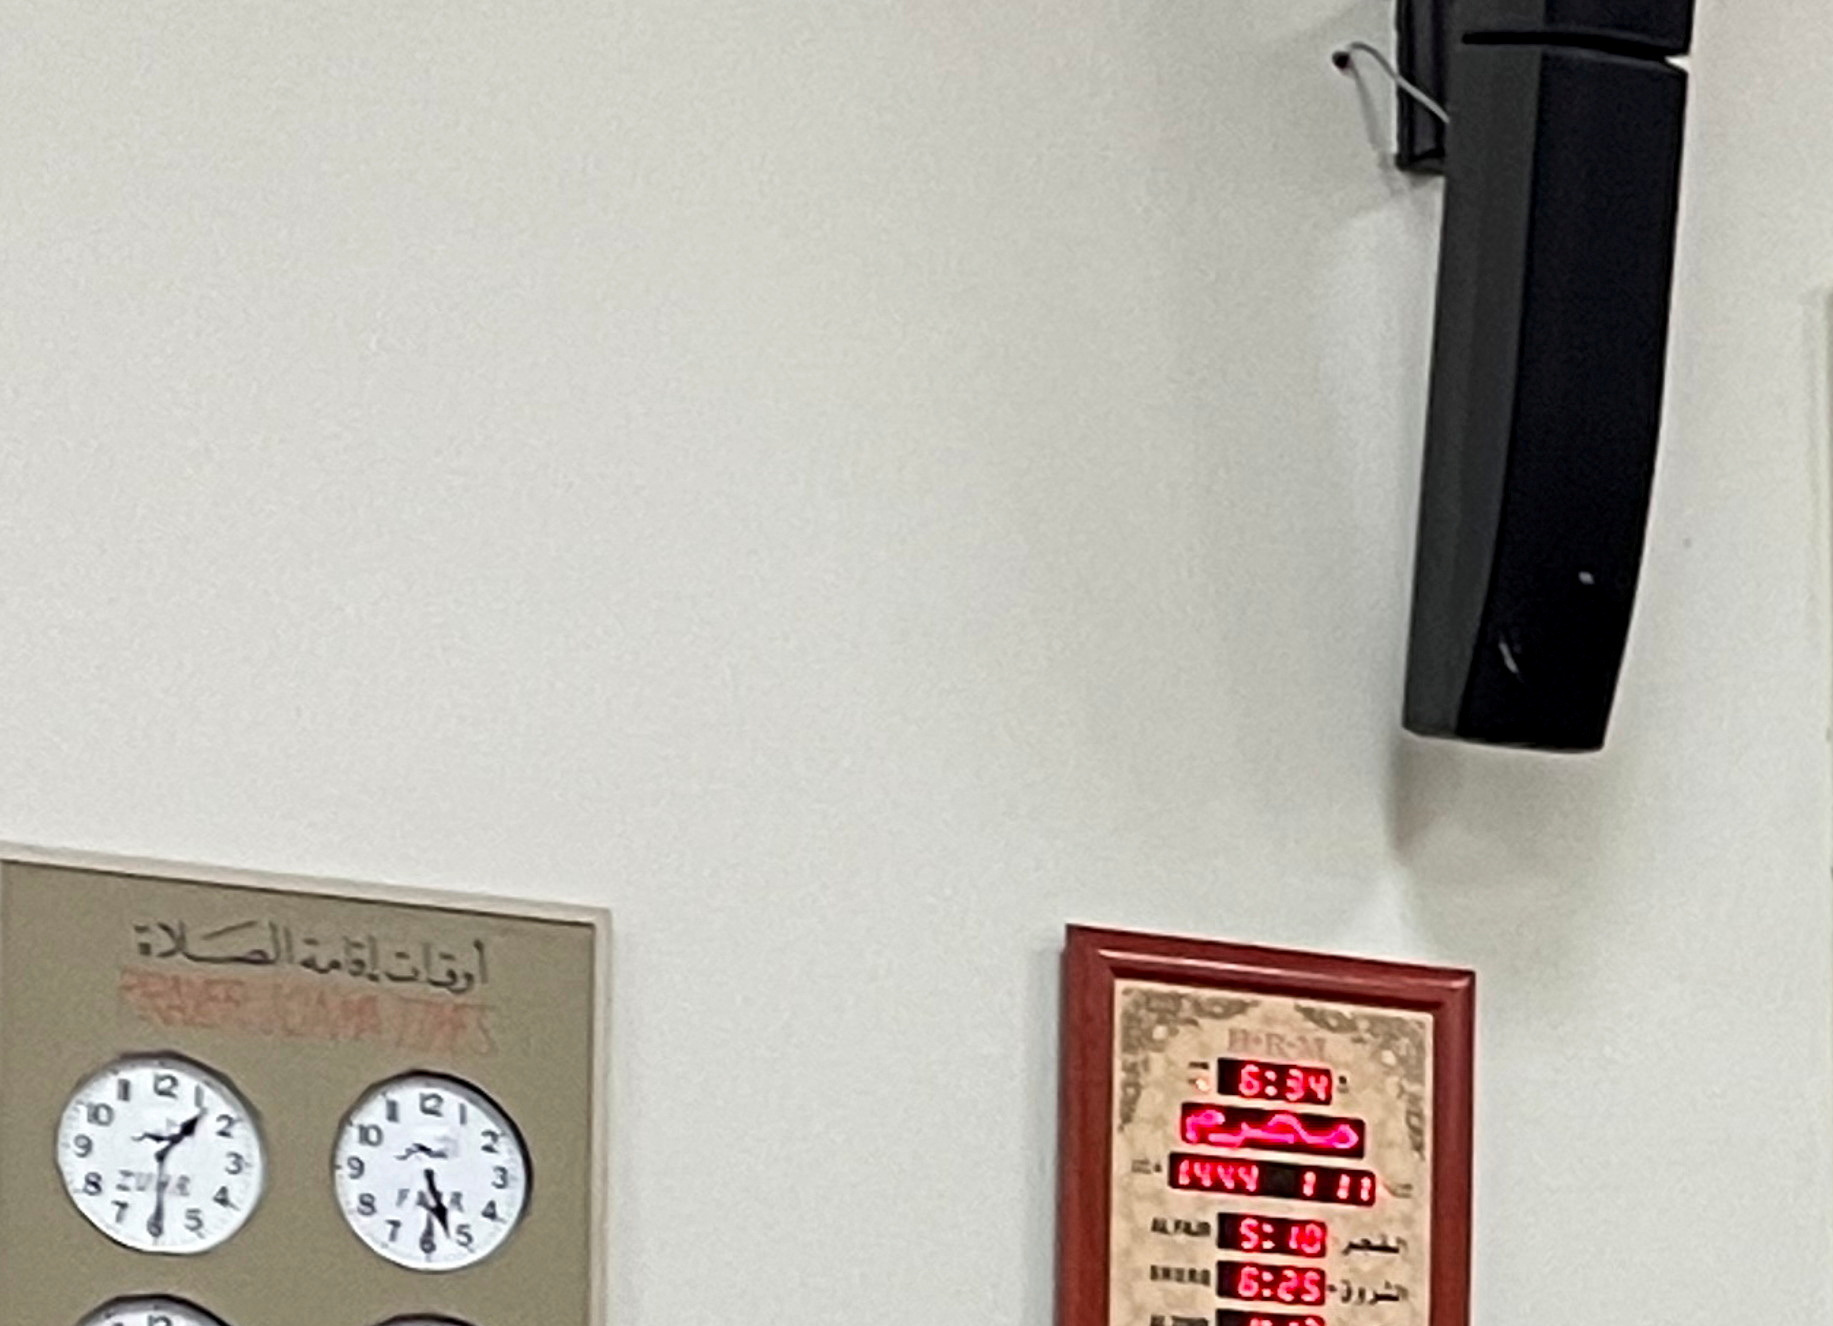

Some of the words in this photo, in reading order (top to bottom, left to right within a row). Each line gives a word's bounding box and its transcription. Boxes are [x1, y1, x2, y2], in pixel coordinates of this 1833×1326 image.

[1239, 1064, 1329, 1101] 6:34
[1178, 1159, 1259, 1192] 1444
[1239, 1217, 1323, 1255] 5:10
[1237, 1266, 1322, 1303] 6:25
